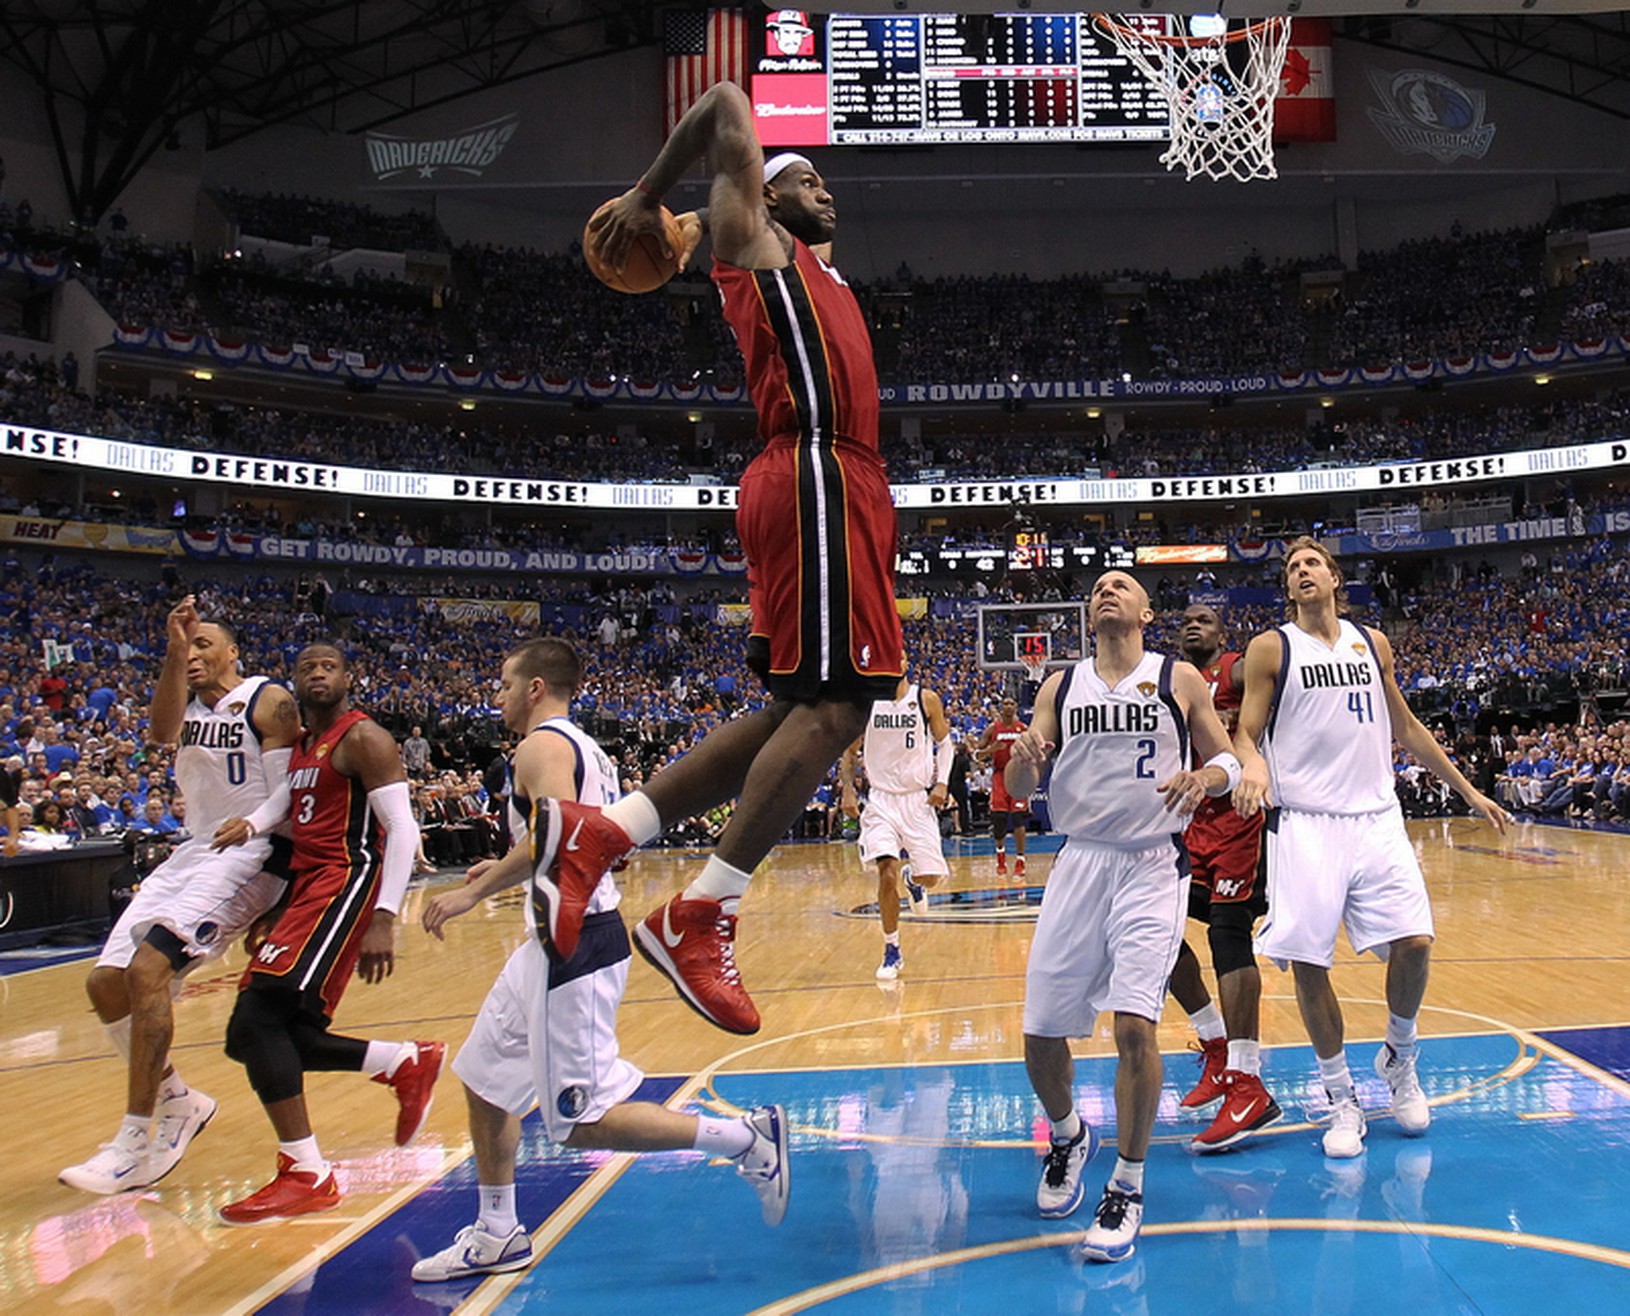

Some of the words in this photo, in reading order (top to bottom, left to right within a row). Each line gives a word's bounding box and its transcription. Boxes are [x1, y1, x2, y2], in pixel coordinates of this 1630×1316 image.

[365, 122, 519, 173] MAVERICKS
[907, 381, 1114, 402] ROWDYVILLE
[1125, 381, 1172, 395] ROWDY
[1179, 380, 1224, 393] PROUD
[1232, 377, 1266, 390] LOUD
[106, 443, 175, 474] DALLAS
[191, 455, 339, 488] DEFENSE!
[363, 472, 428, 496] DALLAS
[453, 479, 588, 503] DEFENSE!
[612, 486, 674, 506] DALLAS
[930, 484, 1058, 503] DEFENSE!
[1080, 481, 1138, 499] DALLAS
[1151, 476, 1276, 498] DEFENSE!
[1299, 470, 1356, 492] DALLAS
[1379, 457, 1505, 486] DEFENSE!
[1527, 448, 1589, 471] DALLAS
[13, 520, 66, 540] HEAT
[1451, 523, 1498, 546] THE
[1505, 517, 1567, 539] TIME
[260, 537, 309, 558] GET
[317, 543, 416, 568] ROWDY,
[424, 548, 518, 571] PROUD,
[525, 552, 578, 570] AND
[585, 554, 657, 573] LOUD!
[1026, 635, 1044, 653] 15
[1301, 661, 1373, 690] DALLAS
[874, 713, 917, 729] DALLAS
[1069, 702, 1159, 737] DALLAS
[1348, 690, 1374, 724] 41
[181, 720, 244, 749] DALLAS
[905, 731, 915, 750] 6
[226, 752, 246, 786] 0
[1136, 738, 1156, 780] 2
[298, 793, 316, 825] 3
